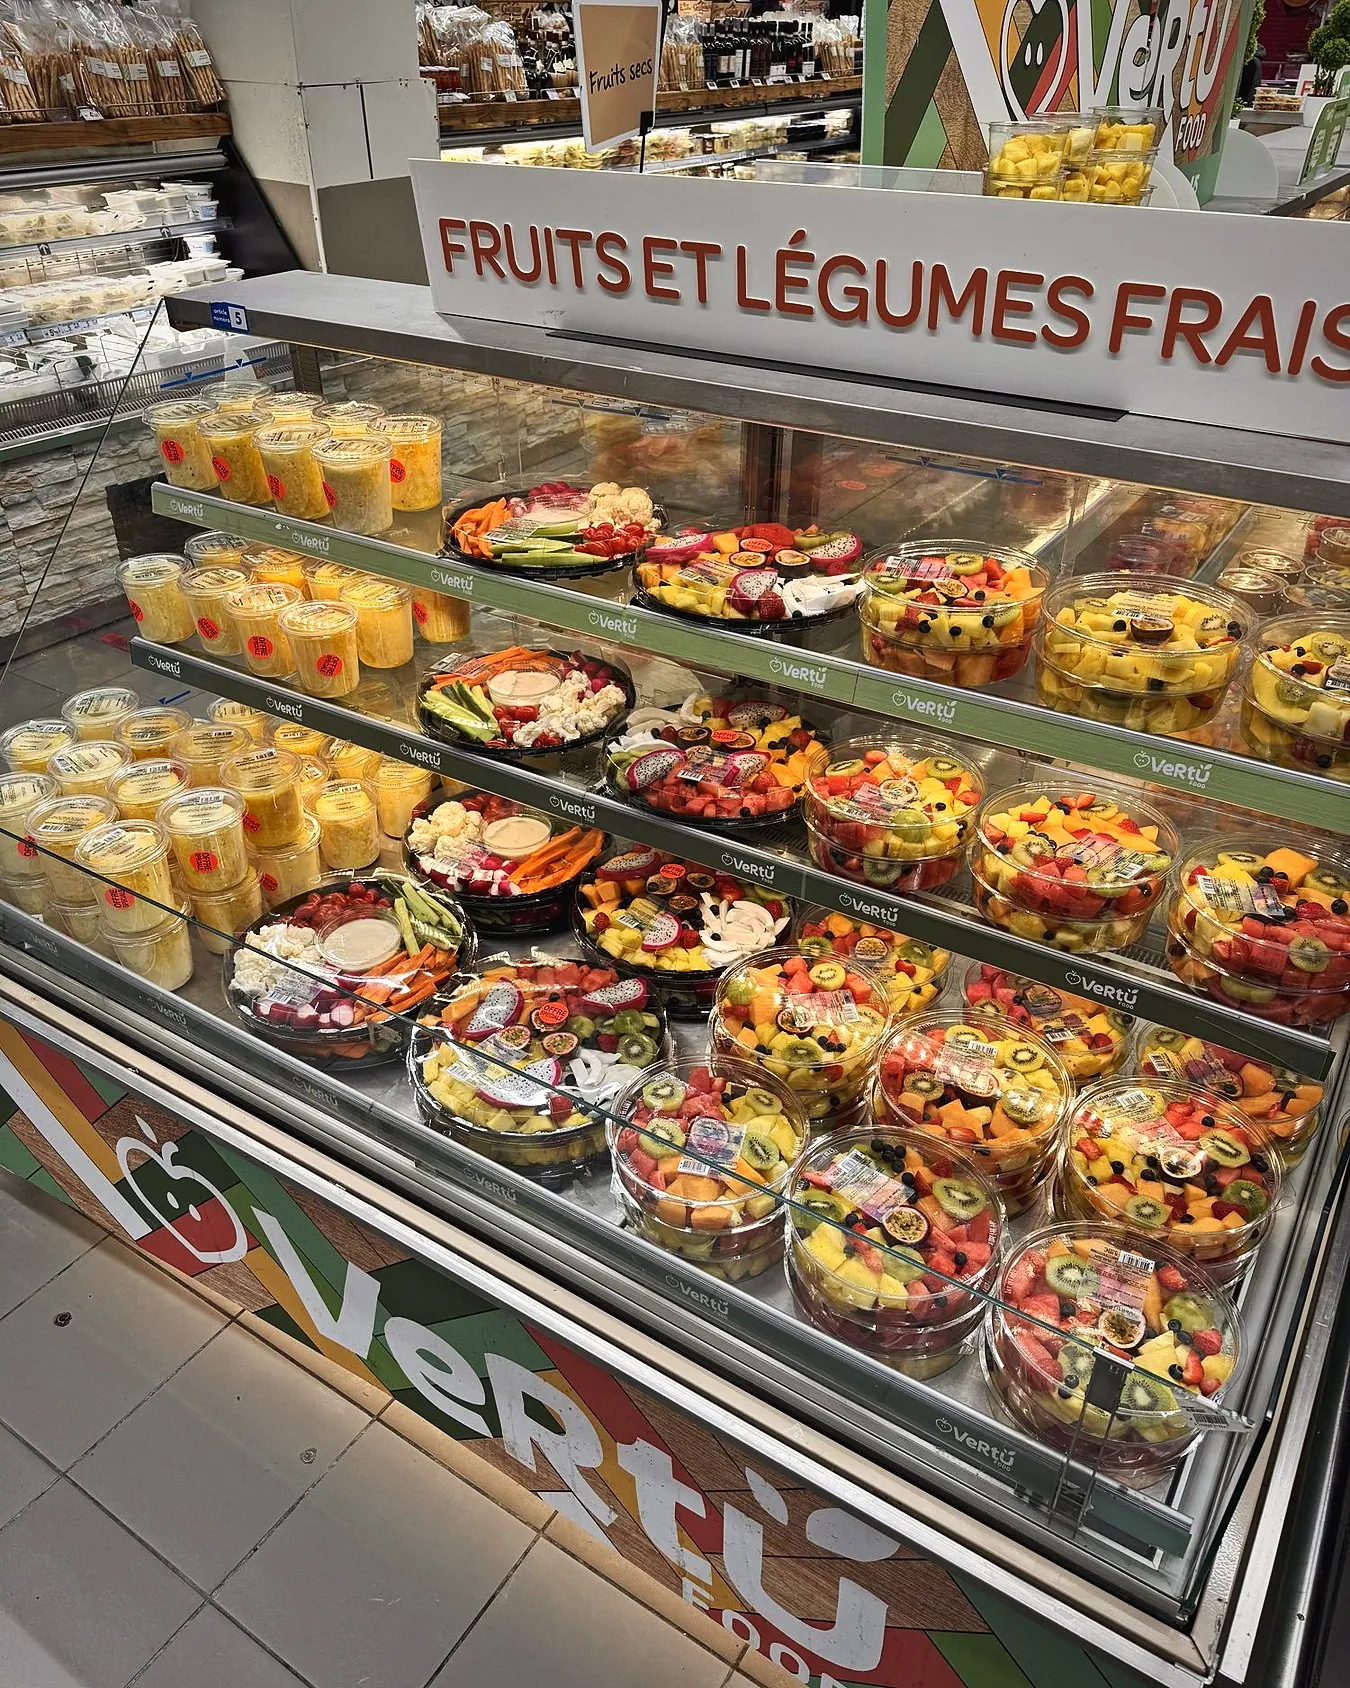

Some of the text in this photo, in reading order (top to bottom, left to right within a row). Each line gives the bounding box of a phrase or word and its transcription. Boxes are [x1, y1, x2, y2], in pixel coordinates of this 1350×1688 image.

[589, 58, 653, 95] Fruits secs
[1175, 112, 1207, 152] FOOD
[439, 217, 1350, 382] FRUITS ET LÉGUMES FRAIS
[234, 311, 243, 326] 5
[259, 636, 269, 657] OFFRE
[326, 656, 340, 677] OFFRE
[938, 716, 953, 724] FOOD
[1188, 780, 1206, 789] FOOD
[202, 851, 212, 872] OFFRE
[883, 919, 897, 927] FOOD
[544, 1004, 568, 1017] OFFRE
[1118, 1001, 1134, 1010] FOOD
[992, 1459, 1012, 1472] FOOD
